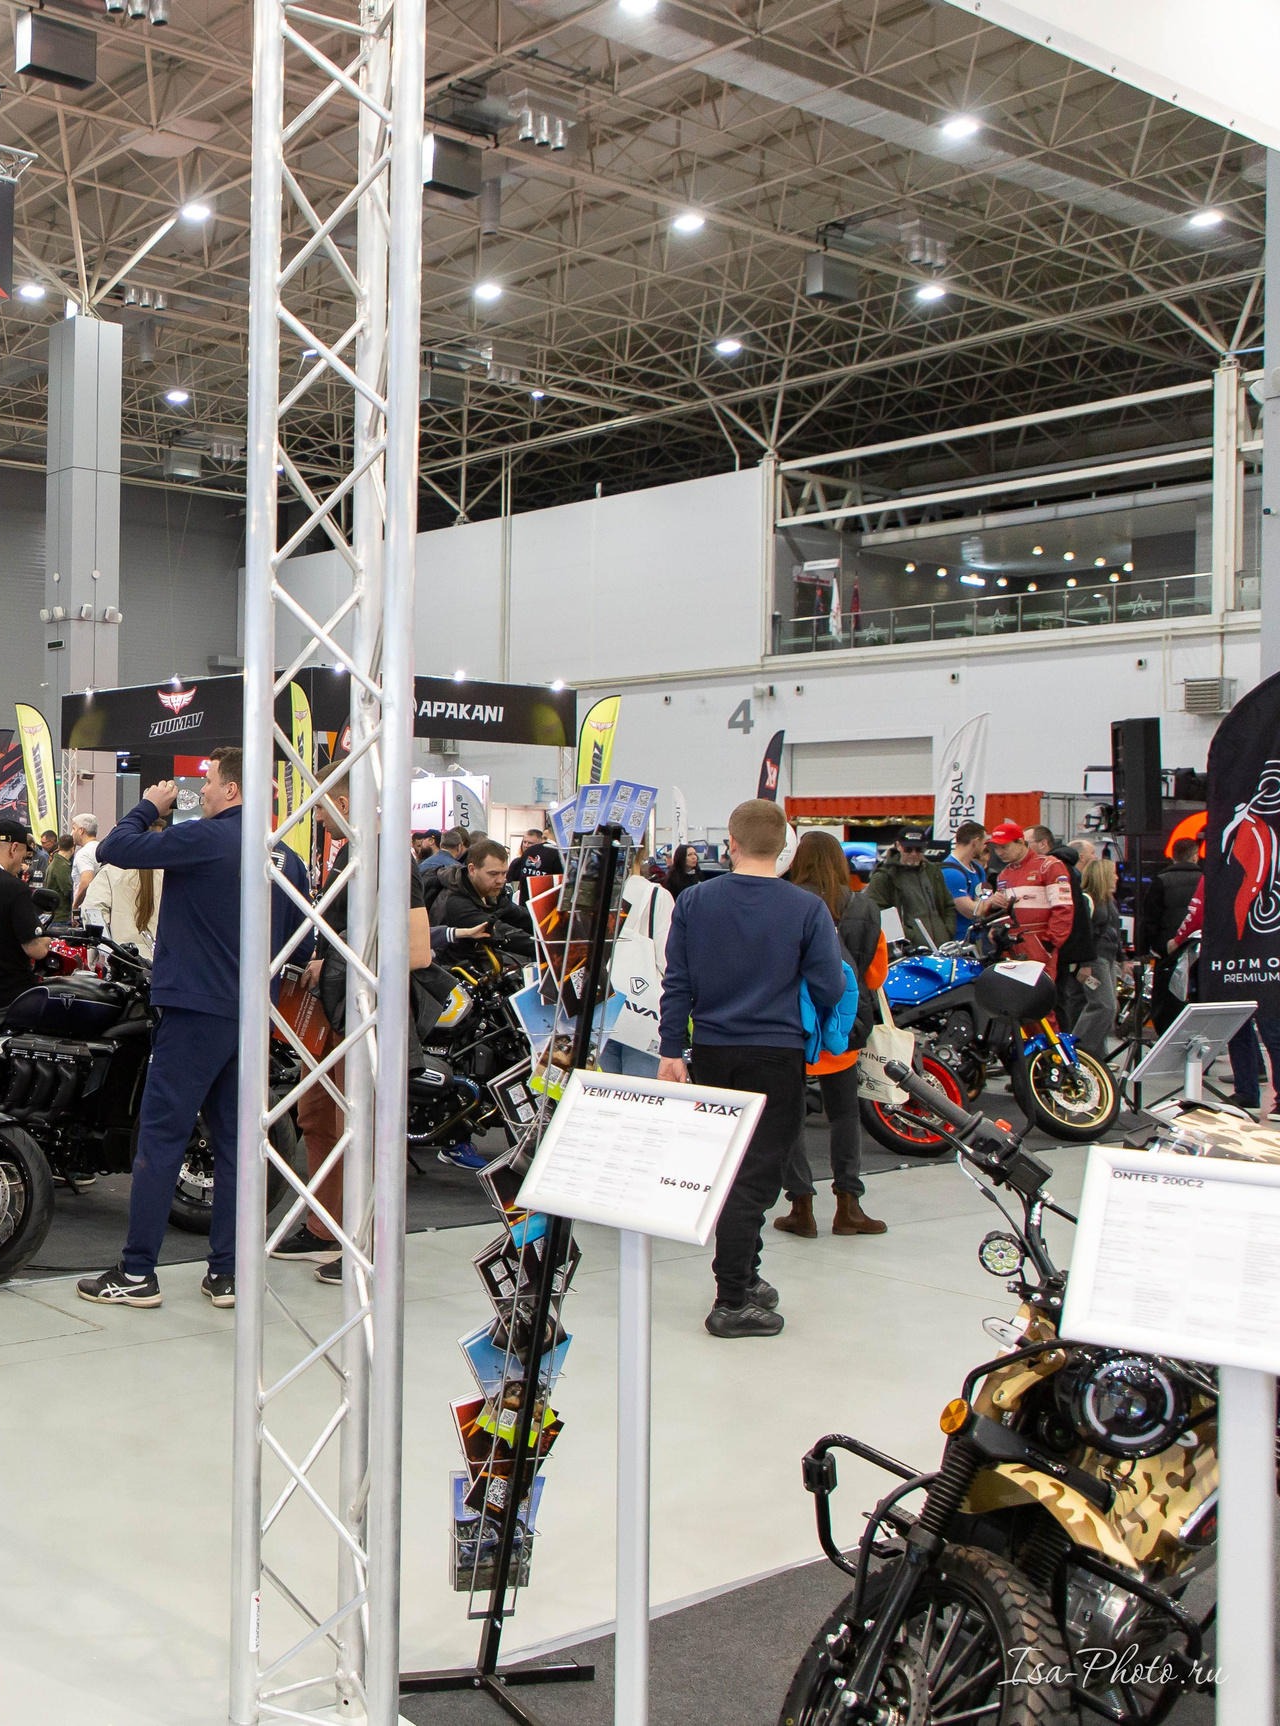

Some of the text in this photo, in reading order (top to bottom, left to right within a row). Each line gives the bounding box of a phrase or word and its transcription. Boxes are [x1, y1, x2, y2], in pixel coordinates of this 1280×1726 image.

[149, 711, 204, 738] ZUUMAV
[728, 699, 754, 734] 4
[1211, 957, 1280, 971] HOTMO
[1223, 971, 1280, 984] PREMIUM
[857, 1050, 887, 1064] HINE
[582, 1086, 665, 1106] YEMI HUNTER
[694, 1101, 743, 1118] ATAK
[659, 1176, 677, 1187] 164
[679, 1180, 700, 1192] 000
[1112, 1170, 1204, 1189] ONTES 200C2
